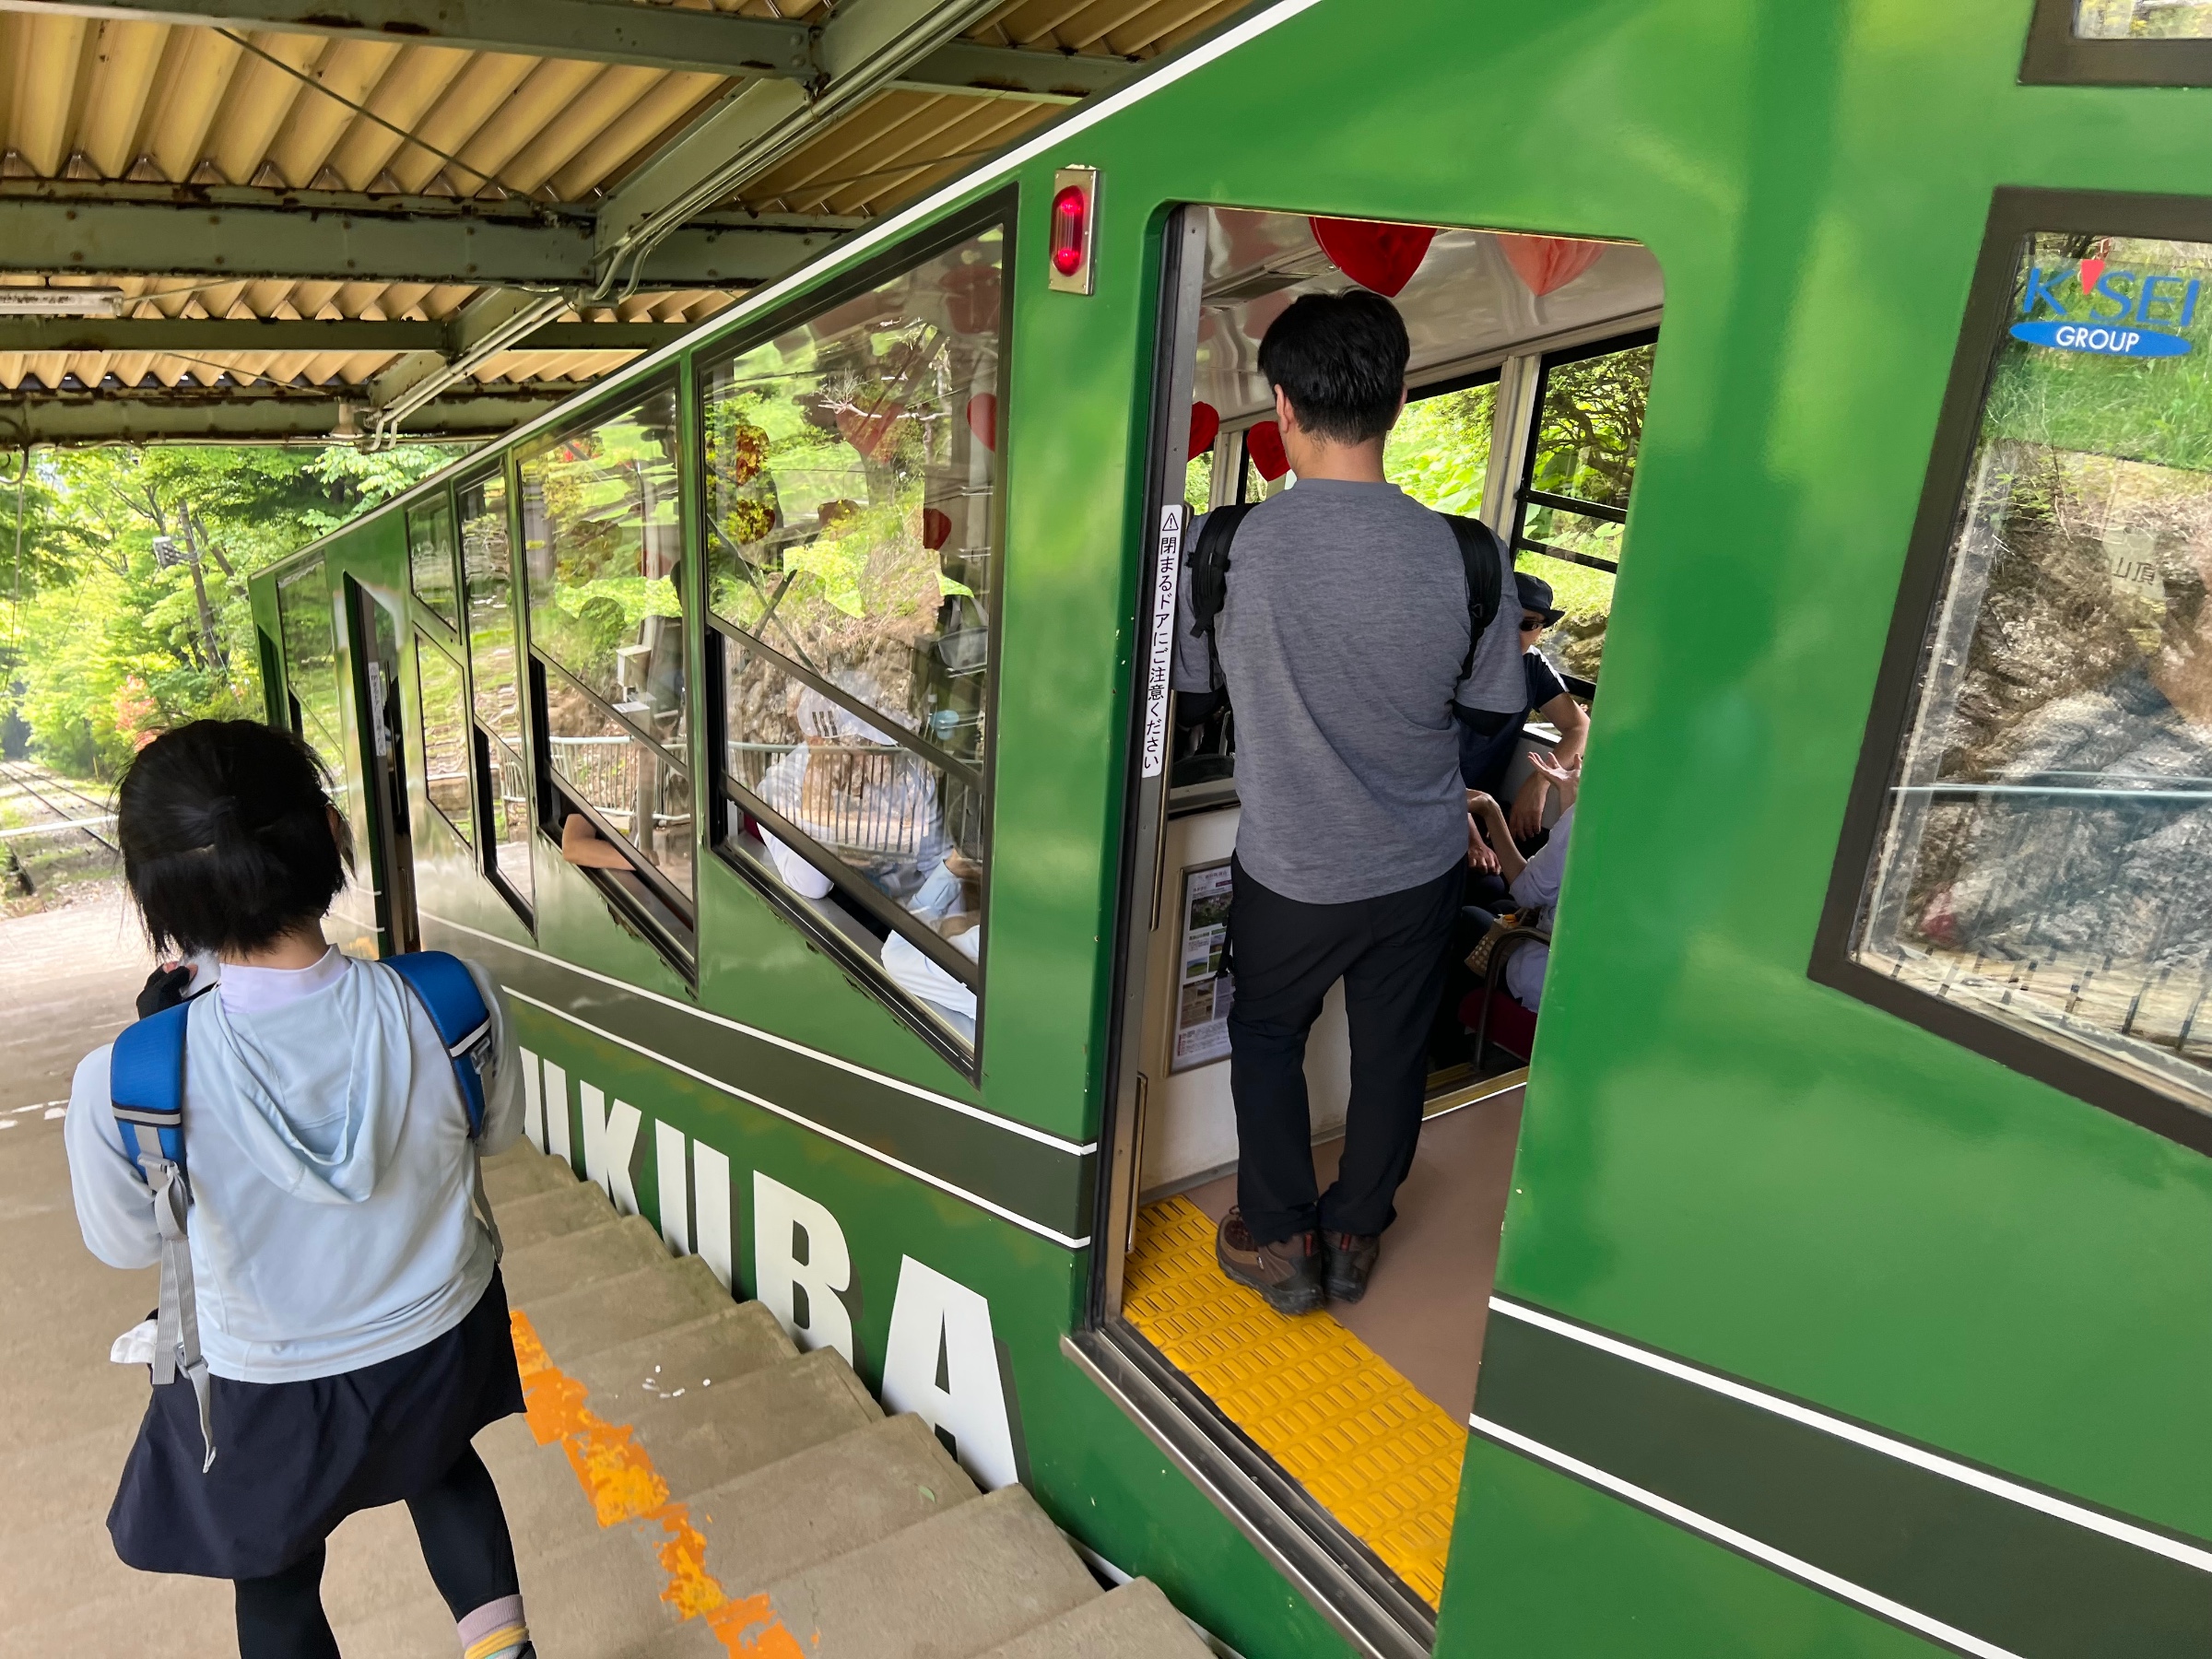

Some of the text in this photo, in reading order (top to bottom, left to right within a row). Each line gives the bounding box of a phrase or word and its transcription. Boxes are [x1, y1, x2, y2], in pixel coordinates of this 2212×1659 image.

[2055, 325, 2140, 352] GROUP
[1144, 535, 1177, 770] 閉まるドアにご注意ください
